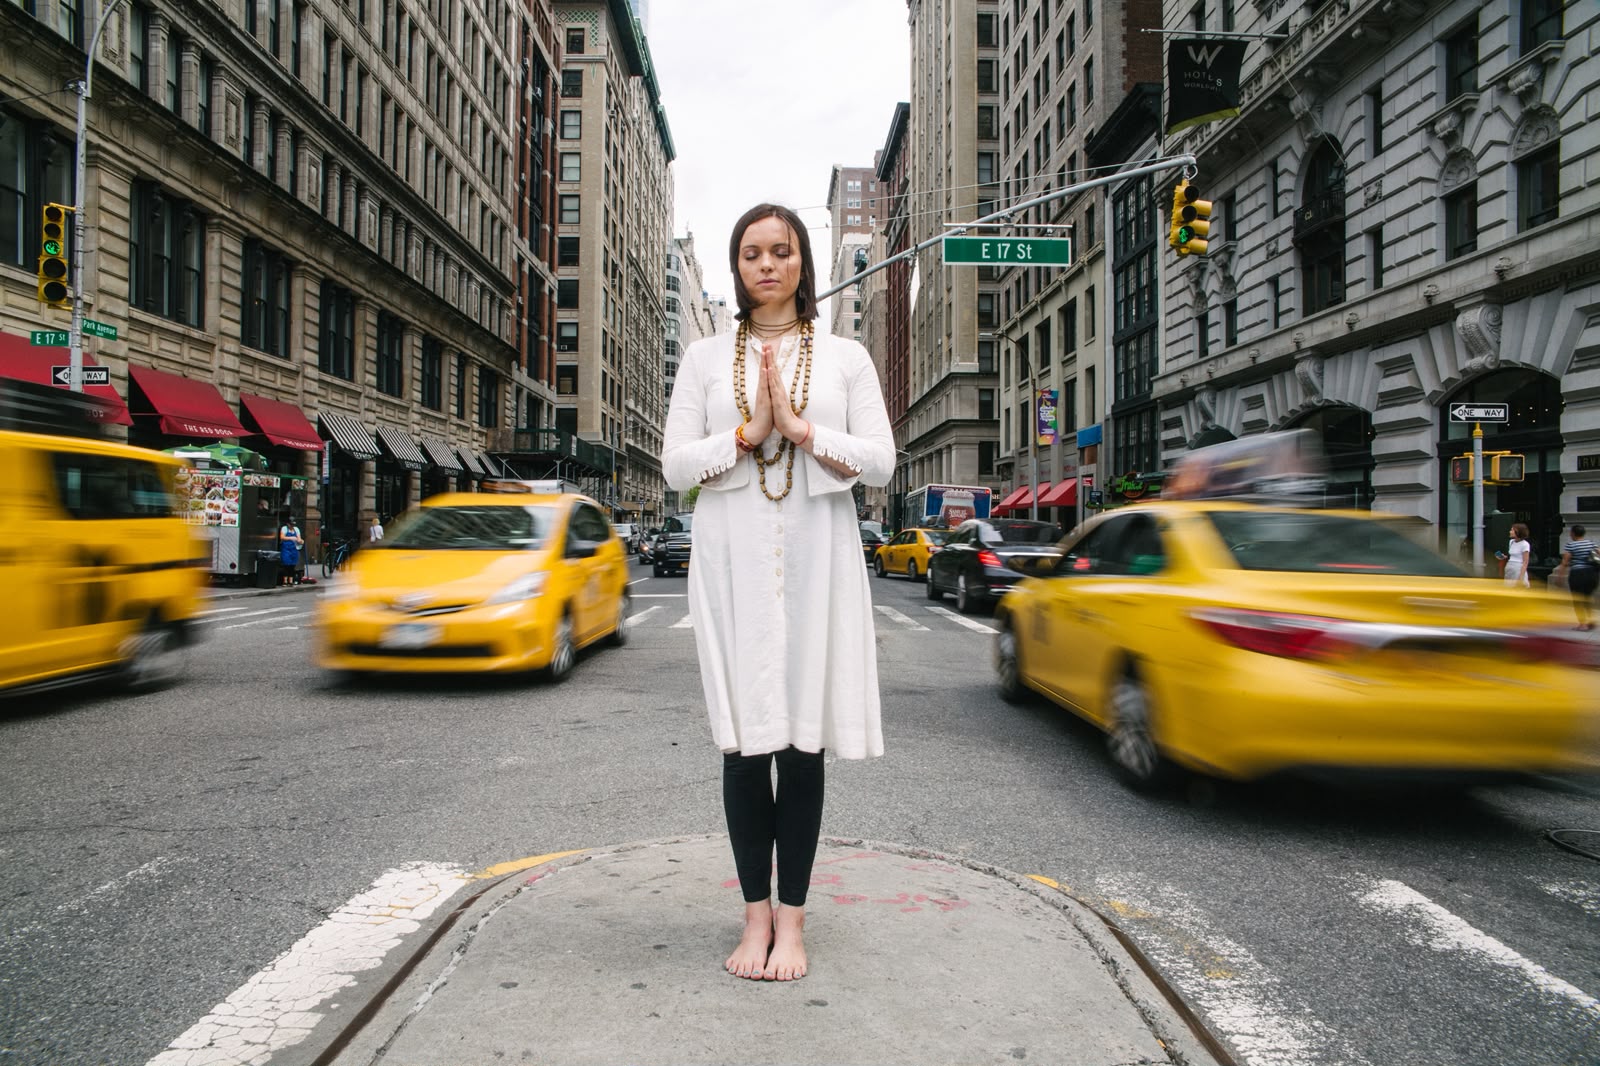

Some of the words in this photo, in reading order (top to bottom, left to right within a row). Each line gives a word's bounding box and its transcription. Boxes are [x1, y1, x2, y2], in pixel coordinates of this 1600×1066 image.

[1186, 45, 1224, 70] W
[1183, 71, 1223, 87] HOTLS
[981, 243, 991, 259] E
[997, 243, 1011, 259] 17
[1017, 243, 1032, 259] St
[83, 319, 96, 331] Park
[97, 323, 116, 336] Avenue
[36, 333, 41, 345] E
[45, 333, 55, 345] 17
[58, 333, 66, 341] St
[86, 372, 103, 380] WAY
[1457, 409, 1475, 417] ONE
[1484, 409, 1502, 417] WAY
[184, 424, 198, 433] THE
[199, 426, 214, 435] RED
[214, 428, 233, 436] DOOR
